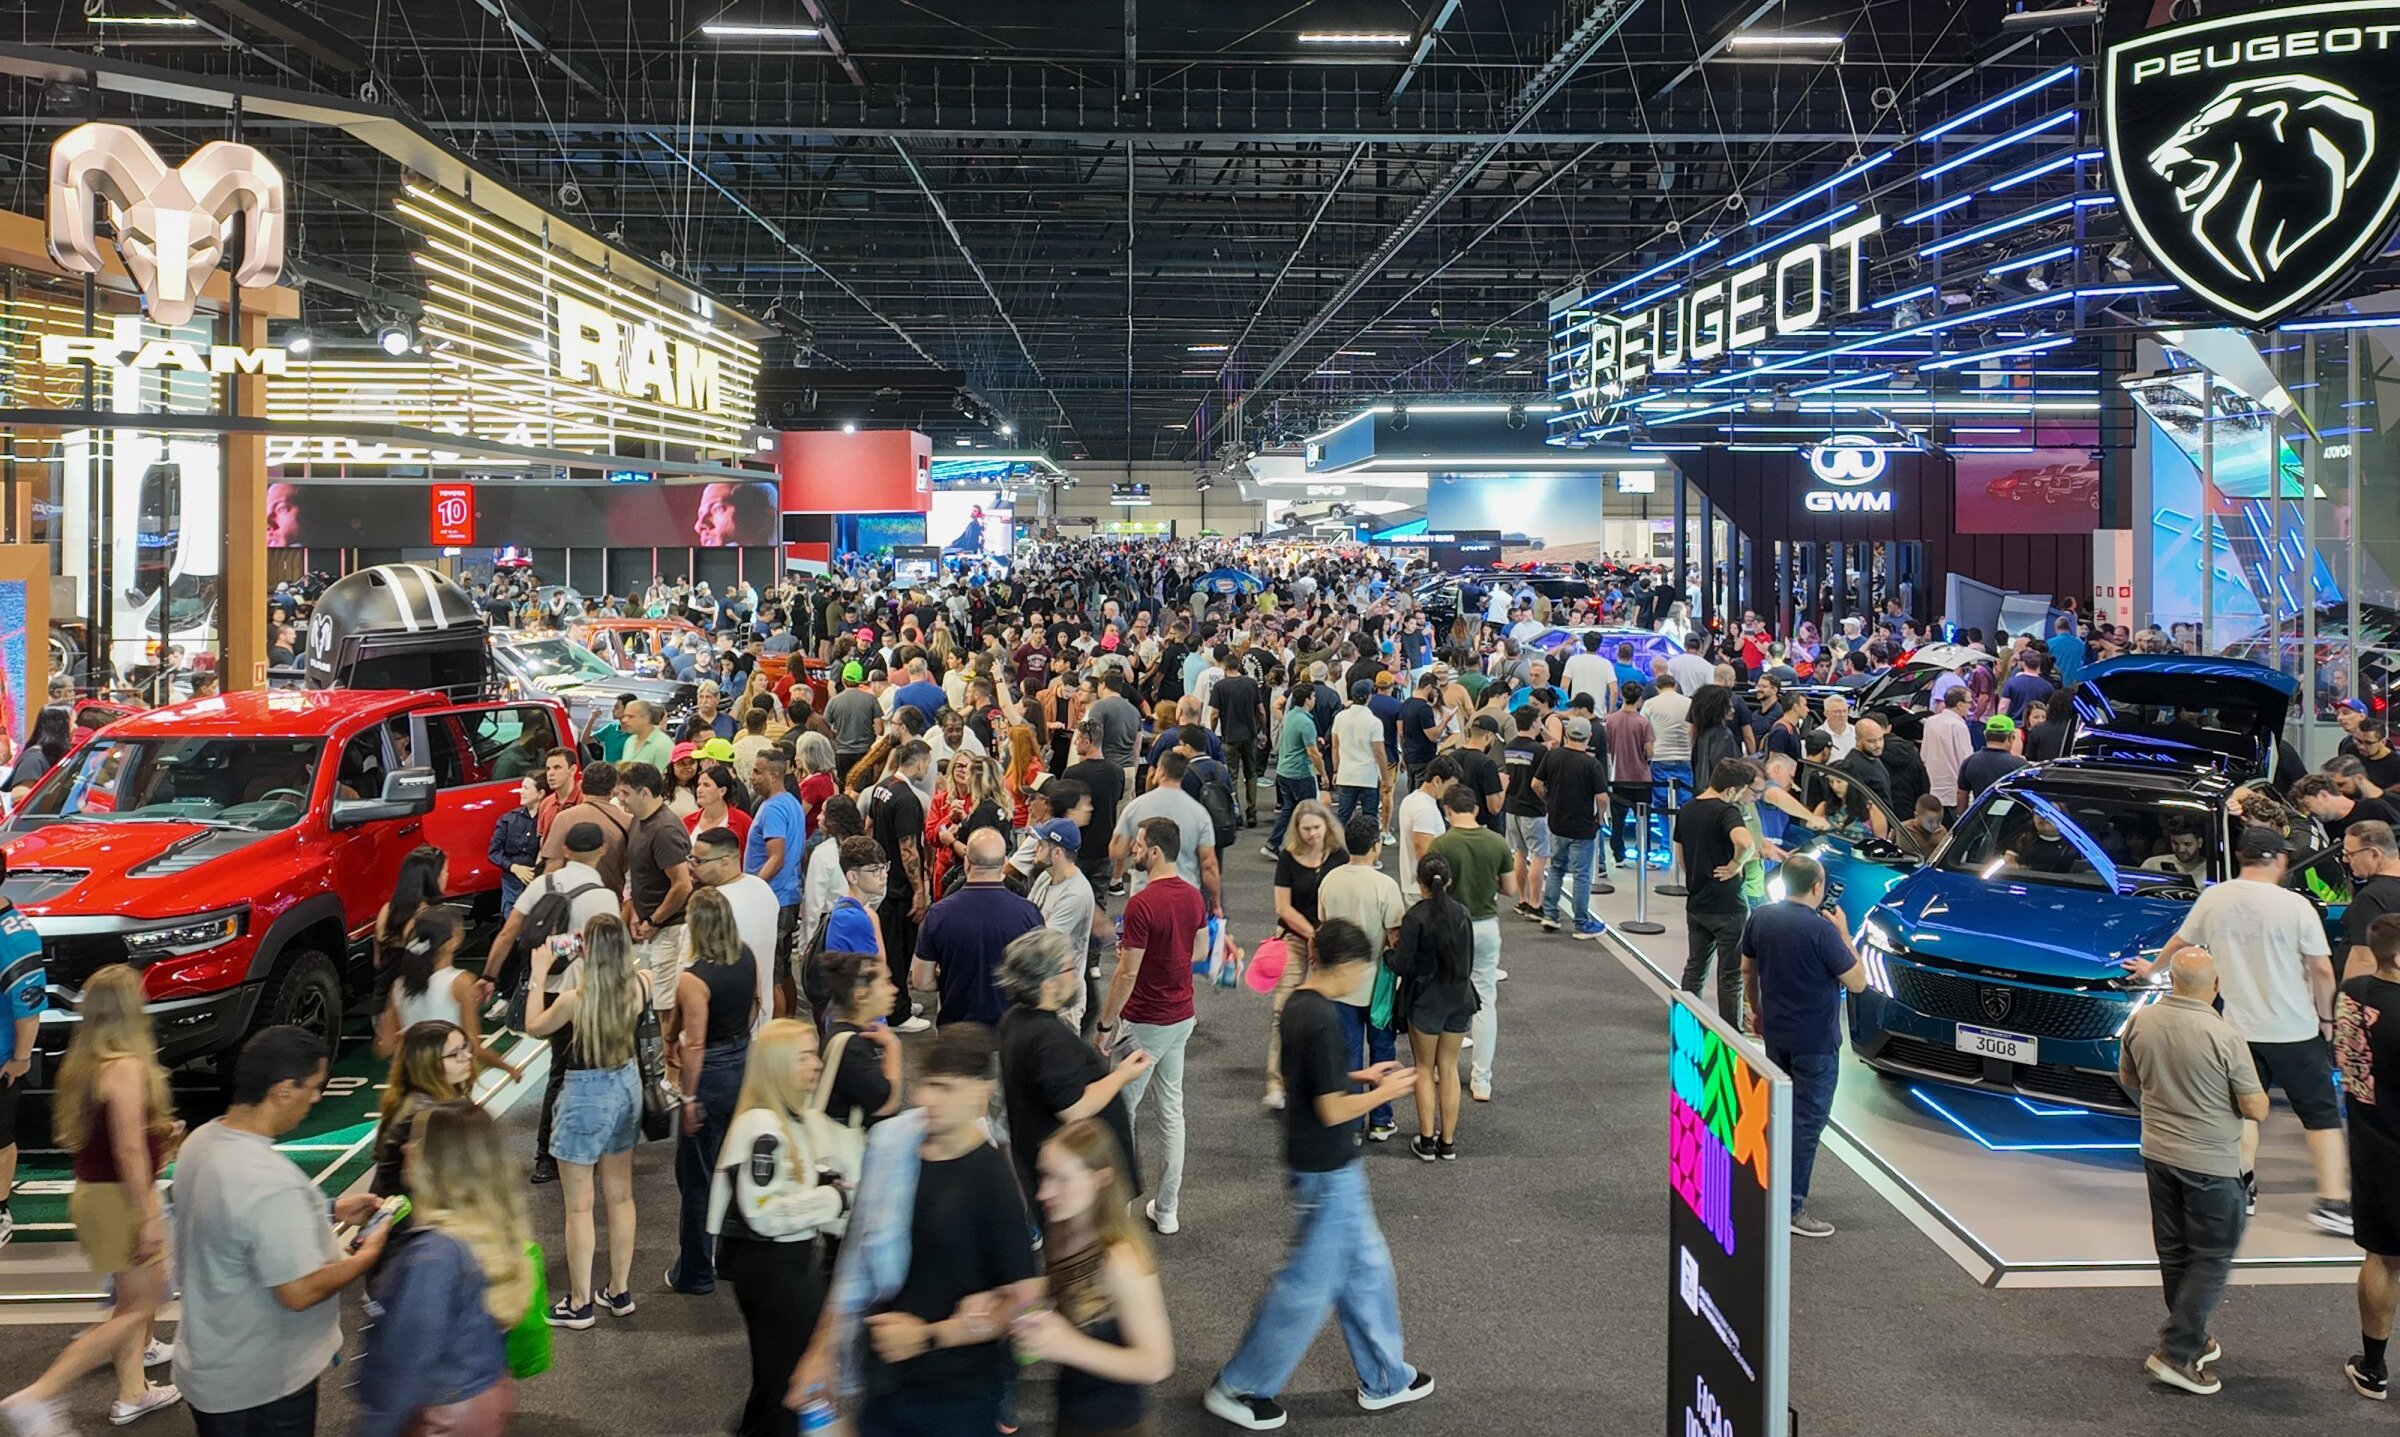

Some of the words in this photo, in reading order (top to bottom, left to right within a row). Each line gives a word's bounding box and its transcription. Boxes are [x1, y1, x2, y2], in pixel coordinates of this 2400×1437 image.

[2133, 25, 2400, 85] PEUGEOT
[1591, 214, 1882, 407] PEUGEOT
[40, 334, 288, 375] RAM
[558, 292, 721, 415] RAM
[438, 498, 467, 527] 10
[1805, 491, 1891, 512] GWM
[1976, 1036, 2017, 1057] 3008
